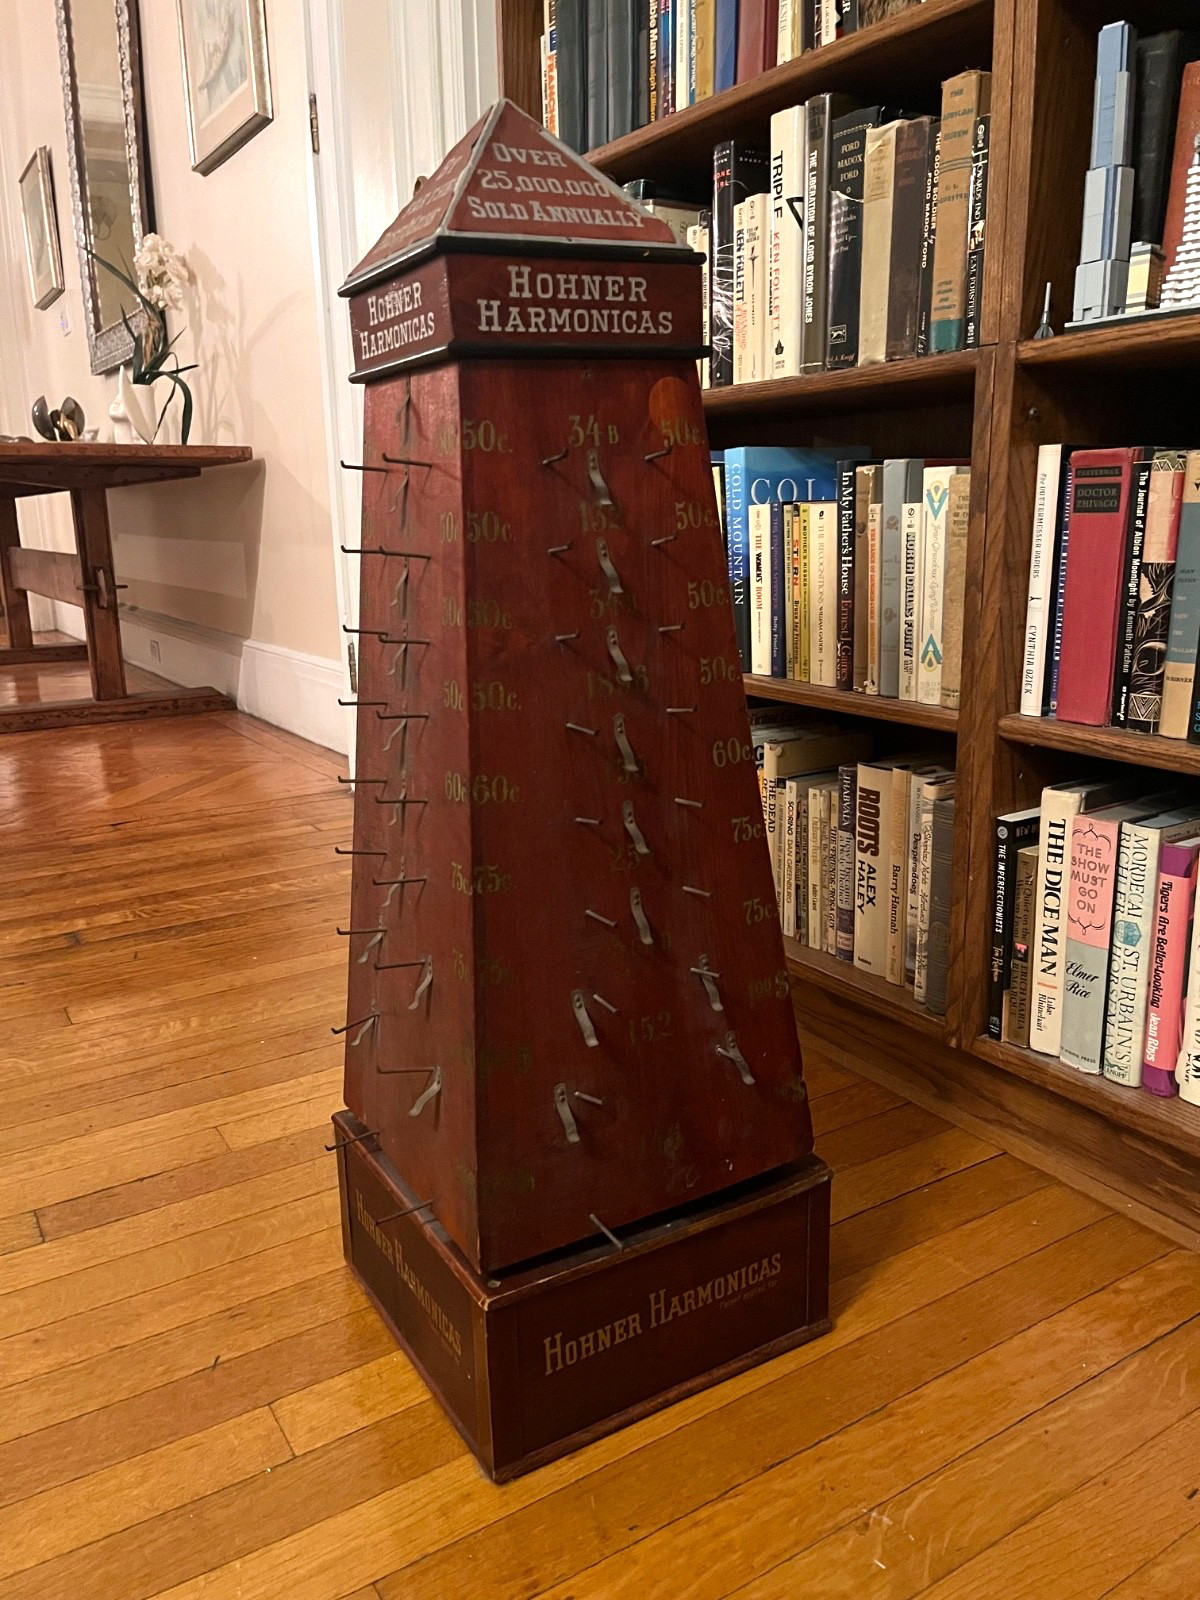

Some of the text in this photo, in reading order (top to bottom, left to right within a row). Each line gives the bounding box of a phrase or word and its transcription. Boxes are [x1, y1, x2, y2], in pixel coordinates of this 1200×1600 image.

[949, 88, 964, 97] THE
[493, 142, 567, 168] OVER
[841, 141, 860, 154] FORD
[943, 130, 969, 141] QUEEN
[837, 154, 863, 168] MADOX
[840, 170, 859, 182] FORD
[477, 169, 614, 198] 25,000,000
[468, 197, 529, 221] SOLD
[533, 201, 644, 229] ANNUALLY
[923, 203, 931, 239] MADOX
[772, 150, 783, 332] TRIPLE KEN FOLLETT
[805, 150, 818, 324] THE LIBERATION OF LORD BYRON JONES
[508, 265, 648, 302] HOHNER
[736, 229, 745, 302] KEN FOLLETT
[367, 281, 422, 327] HOHNER
[477, 298, 674, 334] HARMONICAS
[967, 277, 976, 318] FORSTER
[359, 311, 436, 360] HARMONICAS
[568, 414, 620, 447] 34 B
[842, 471, 853, 485] In
[1077, 469, 1120, 477] PASTERNAK
[1077, 488, 1118, 497] DOCTOR
[840, 487, 853, 508] My
[1035, 485, 1046, 549] PUTTERMESSER
[1076, 499, 1118, 509] ZHIVAGO
[731, 463, 744, 605] COLD MOUNTAIN
[841, 510, 853, 555] Father's
[841, 556, 852, 595] House
[1033, 550, 1041, 579] PAPERS
[1122, 470, 1149, 674] The Journal of Albion Moonlight by Kenneth Patchen
[755, 586, 763, 610] ROOM
[904, 532, 916, 659] NORTH DALLAS FORTY
[841, 600, 852, 633] Ernest
[840, 645, 851, 682] Gaines
[1026, 625, 1037, 666] CYNTHIA
[1024, 668, 1034, 695] OZICK
[767, 778, 777, 834] THE DEAD
[787, 801, 795, 836] SCORING
[842, 775, 851, 827] JHABVALA
[857, 786, 881, 857] ROOTS
[829, 845, 837, 884] FRIENDS
[909, 833, 921, 895] Desperadoes
[1071, 856, 1110, 875] SHOW
[1077, 843, 1102, 859] THE
[857, 859, 866, 915] HALEY
[865, 863, 877, 907] ALEX
[995, 844, 1007, 934] THE IMPERFECTIONISTS
[1070, 870, 1107, 888] MUST
[1078, 886, 1098, 899] GO
[1115, 831, 1131, 915] RICHLER
[1128, 833, 1149, 918] MORDECAI
[890, 864, 901, 934] Barry Hannah
[1021, 887, 1033, 942] Quiet on the
[1040, 818, 1066, 977] THE DICE MAN
[1077, 900, 1096, 914] ON
[1065, 961, 1099, 983] Elmer
[1065, 980, 1092, 999] Rice
[1146, 881, 1173, 1062] Tigers Are Better-Looking Jean Rhys
[1017, 964, 1028, 1030] ERICH MARIA
[1036, 993, 1047, 1032] Rhinehart
[1046, 996, 1056, 1016] Luke
[1105, 943, 1122, 1056] HORSEMAN
[1115, 947, 1140, 1064] ST. URBAIN'S
[1081, 1055, 1097, 1064] PRESS
[355, 1189, 395, 1265] HOHNER
[394, 1238, 462, 1357] HARMONICAS
[543, 1311, 643, 1377] HOHNER
[648, 1252, 782, 1330] HARMONICAS
